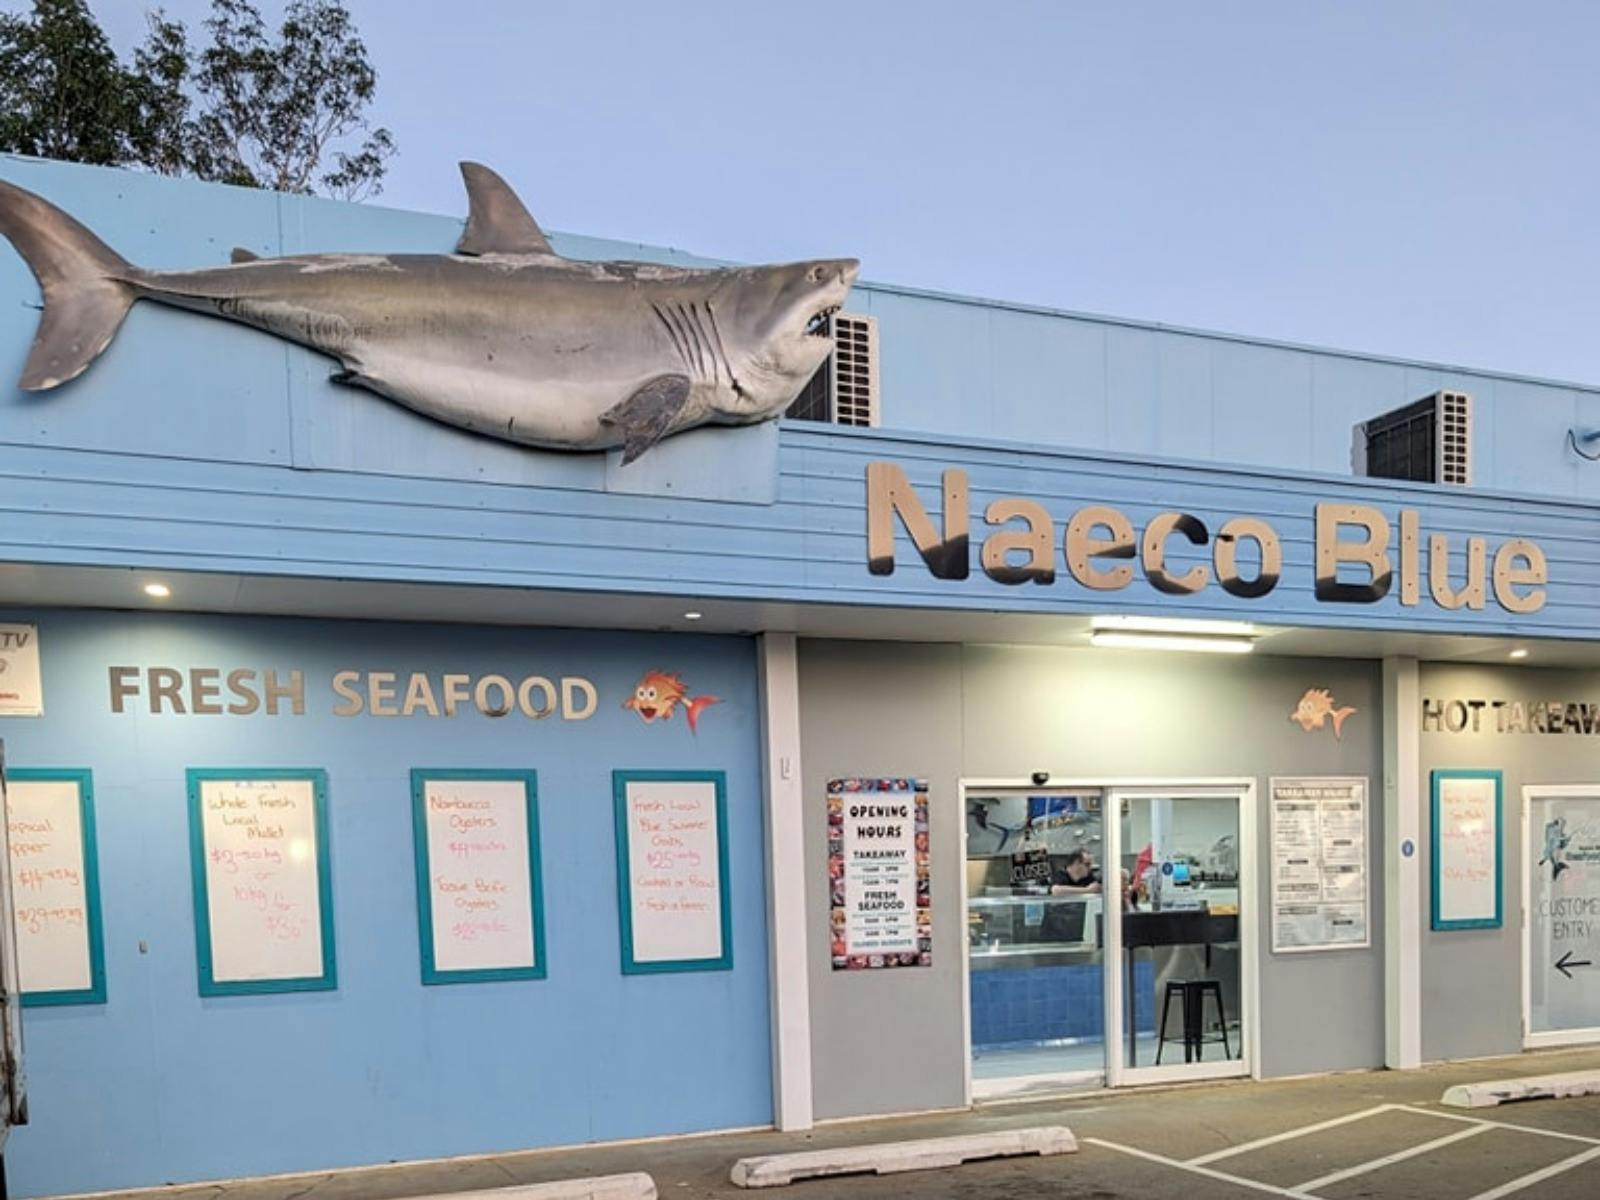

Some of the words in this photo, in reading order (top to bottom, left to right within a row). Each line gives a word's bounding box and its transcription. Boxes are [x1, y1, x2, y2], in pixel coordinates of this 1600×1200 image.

[866, 462, 1282, 598] Naeco
[1314, 502, 1549, 614] Blue
[109, 666, 306, 716] FRESH
[332, 669, 598, 721] SEAFOOD
[1422, 699, 1484, 733] HOT
[1491, 701, 1600, 735] TAKEAW
[849, 804, 908, 818] OPENING
[857, 825, 902, 839] HOURS
[853, 850, 907, 860] TAKEAWAY
[864, 891, 897, 900] FRESH
[857, 900, 906, 912] SEAFOOD
[1553, 921, 1593, 940] ENTRY
